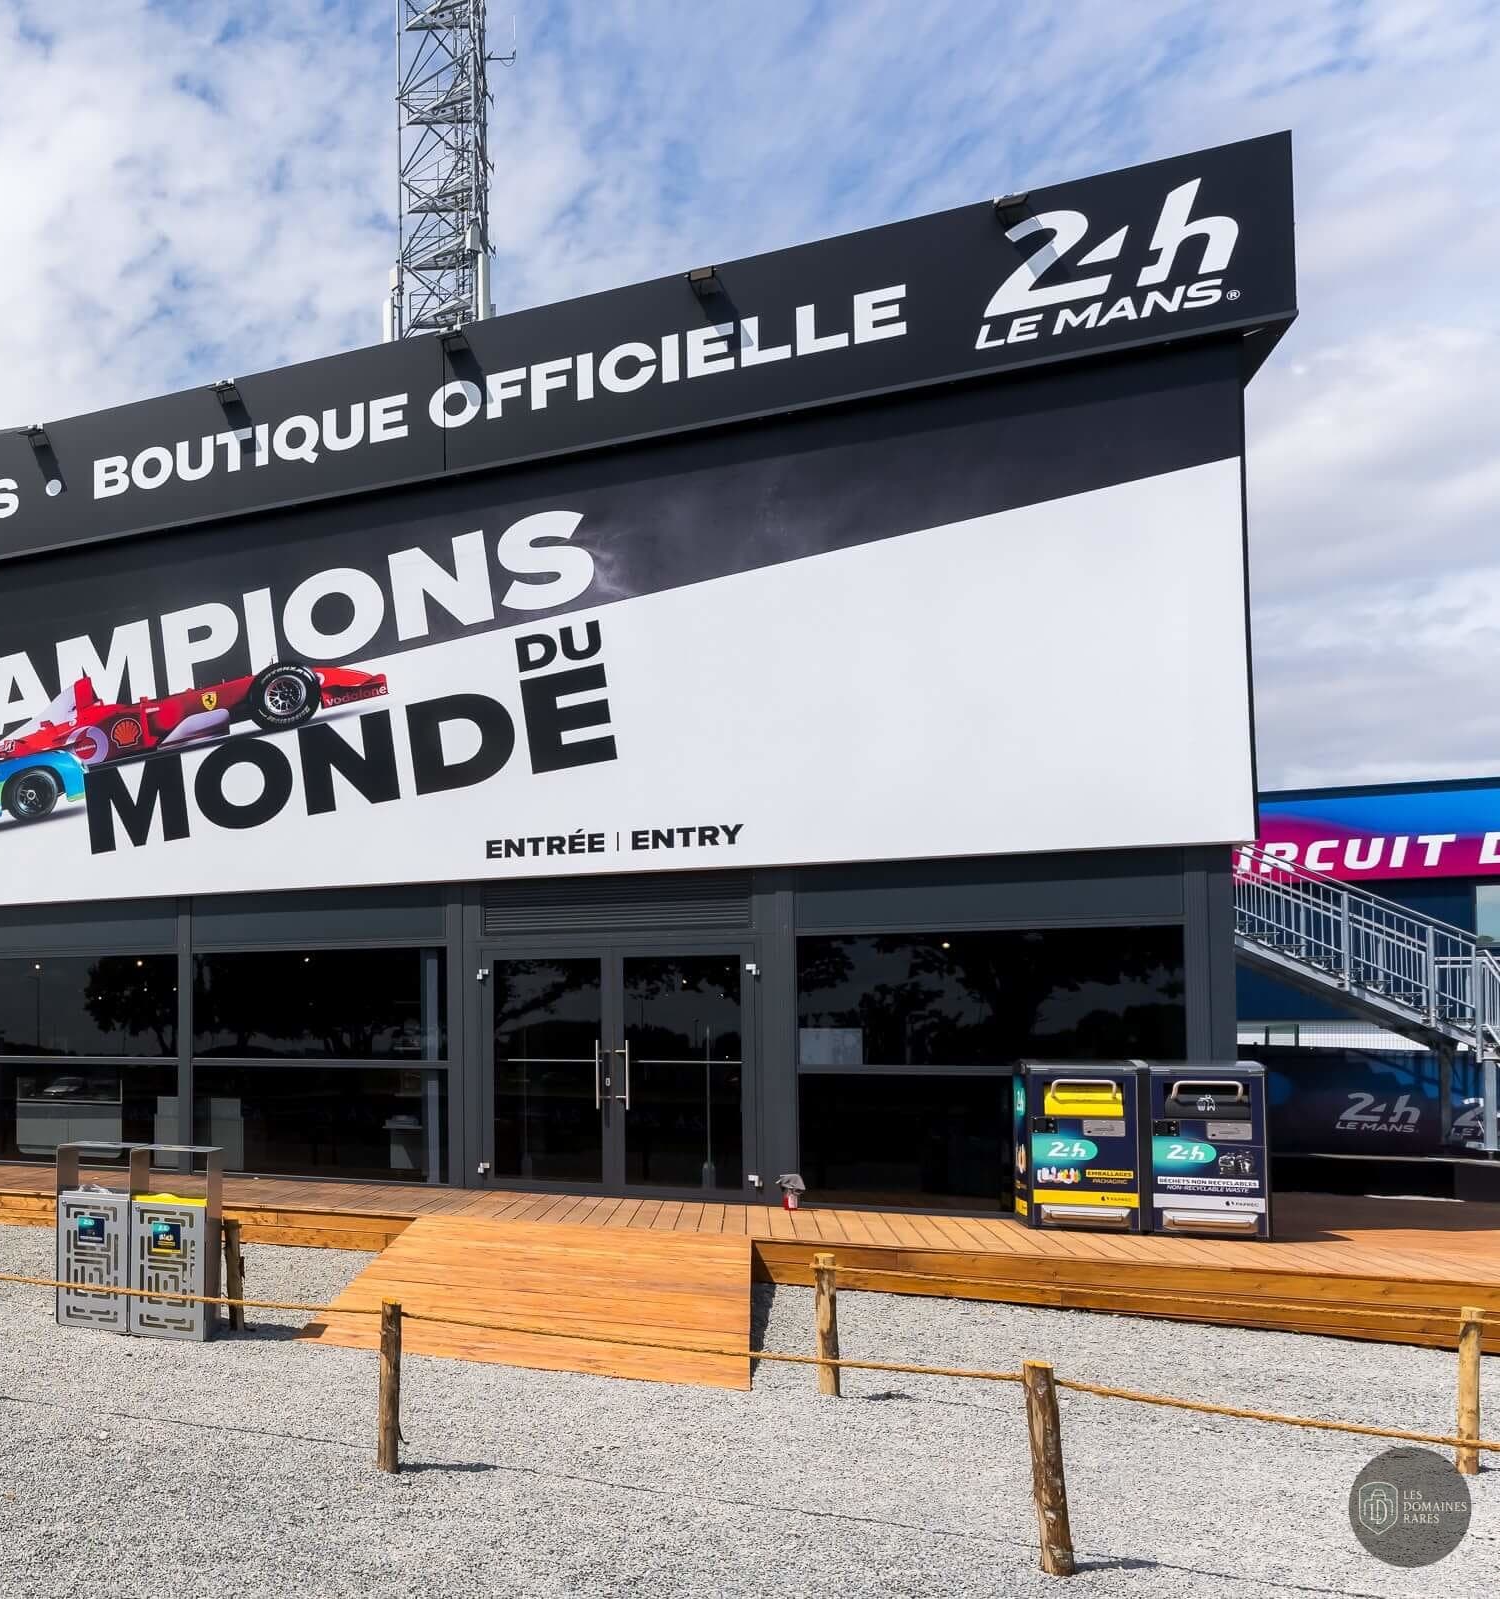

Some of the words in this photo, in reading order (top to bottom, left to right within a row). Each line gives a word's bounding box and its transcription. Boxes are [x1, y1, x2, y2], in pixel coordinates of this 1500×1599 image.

[984, 178, 1239, 318] 24h
[975, 314, 1044, 350] LE
[94, 392, 409, 500] BOUTIQUE
[429, 284, 907, 429] OFFICIELLE
[515, 620, 602, 680] DU
[84, 663, 618, 855] MONDE
[486, 828, 605, 859] ENTRÉE
[632, 824, 744, 851] ENTRY
[1339, 1092, 1421, 1124] 24h
[1335, 1121, 1358, 1130] LE
[1360, 1122, 1415, 1133] MANS
[1048, 1141, 1087, 1158] 24h
[1166, 1144, 1206, 1161] 24h
[1087, 1170, 1133, 1178] EMBALLAGES
